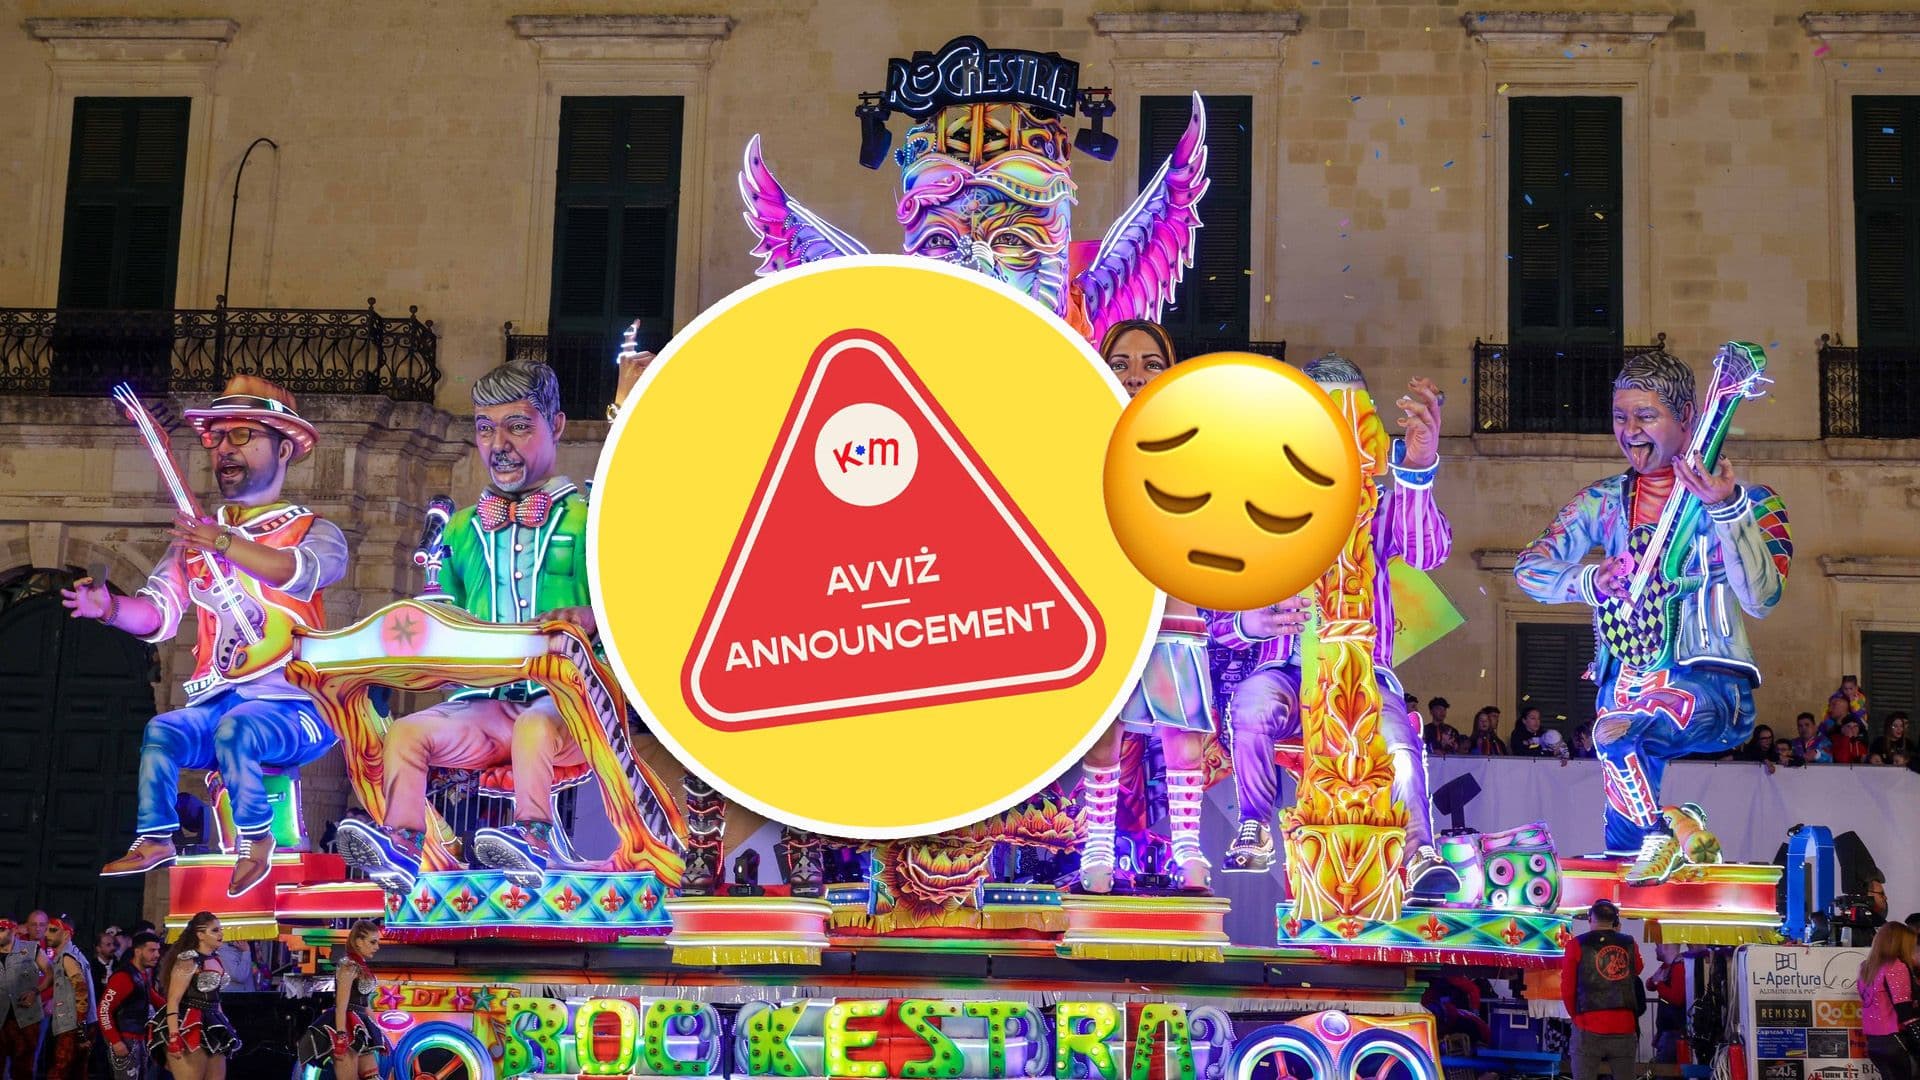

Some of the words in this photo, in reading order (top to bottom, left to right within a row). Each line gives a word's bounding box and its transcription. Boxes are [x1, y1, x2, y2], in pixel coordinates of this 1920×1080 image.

[888, 44, 1078, 111] ROCKESTRA
[1753, 971, 1821, 988] L-Apertura
[1761, 1008, 1807, 1019] REMISSA
[502, 997, 1197, 1080] ROCKESTRA
